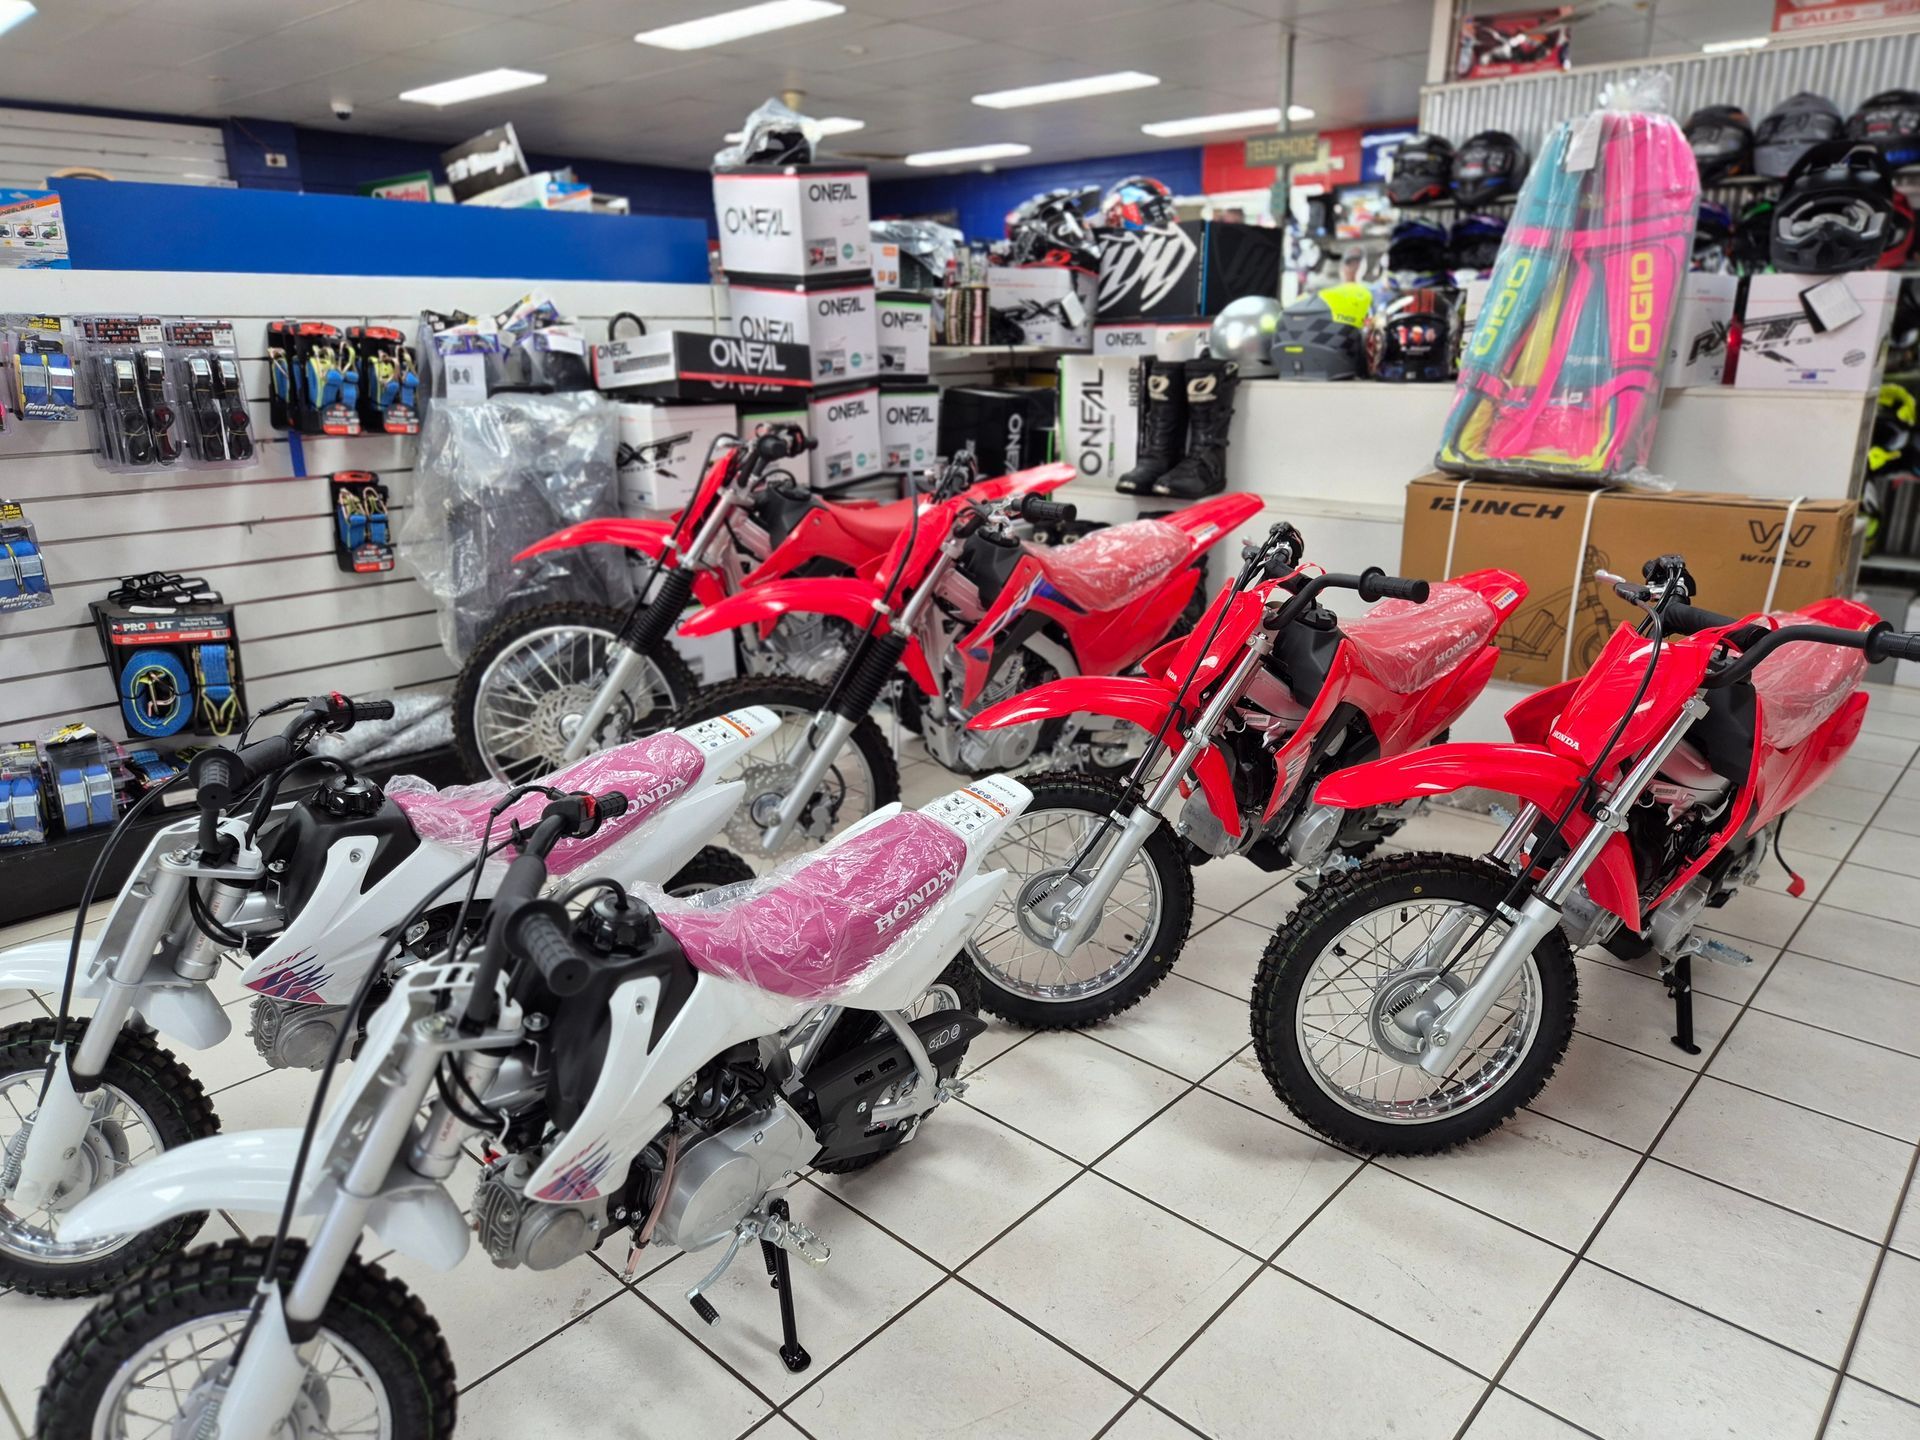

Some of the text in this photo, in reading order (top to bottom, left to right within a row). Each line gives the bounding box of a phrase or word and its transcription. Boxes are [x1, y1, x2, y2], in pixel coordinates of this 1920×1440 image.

[1248, 138, 1316, 161] TELEPHONE
[1472, 258, 1532, 357] OGIO
[1628, 252, 1654, 353] OGIO
[1429, 496, 1566, 520] 12 INCH
[1128, 558, 1171, 586] HONDA
[1740, 553, 1812, 569] WIRED
[1434, 630, 1478, 665] HONDA
[1551, 730, 1580, 751] HONDA
[626, 776, 687, 815] ONDA
[874, 868, 955, 935] HONDA
